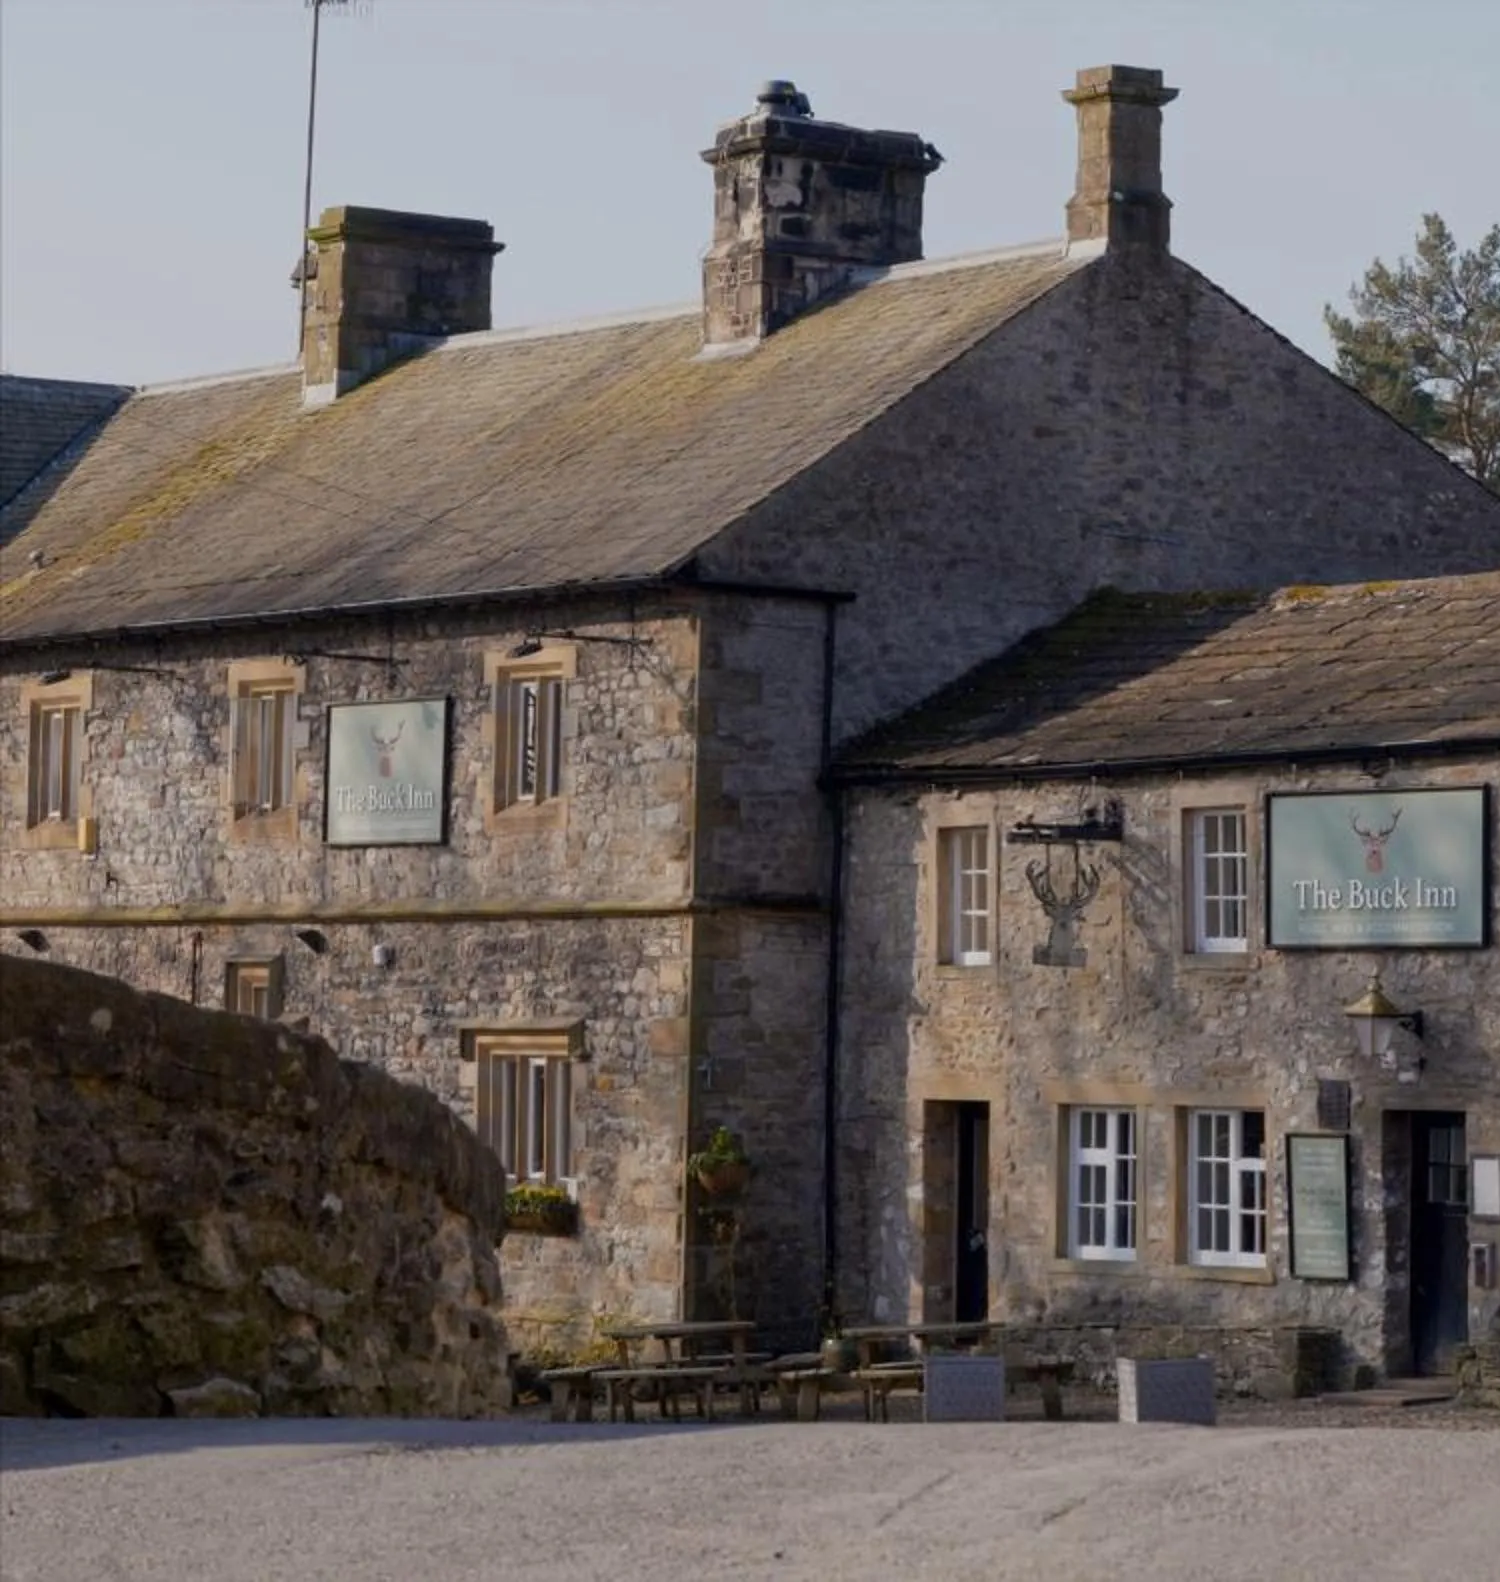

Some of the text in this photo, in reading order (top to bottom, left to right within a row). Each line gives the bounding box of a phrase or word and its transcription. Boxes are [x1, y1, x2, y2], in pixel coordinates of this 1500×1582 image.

[368, 783, 405, 811] Buck
[408, 783, 434, 810] Inn
[1293, 876, 1457, 910] The Buck Inn
